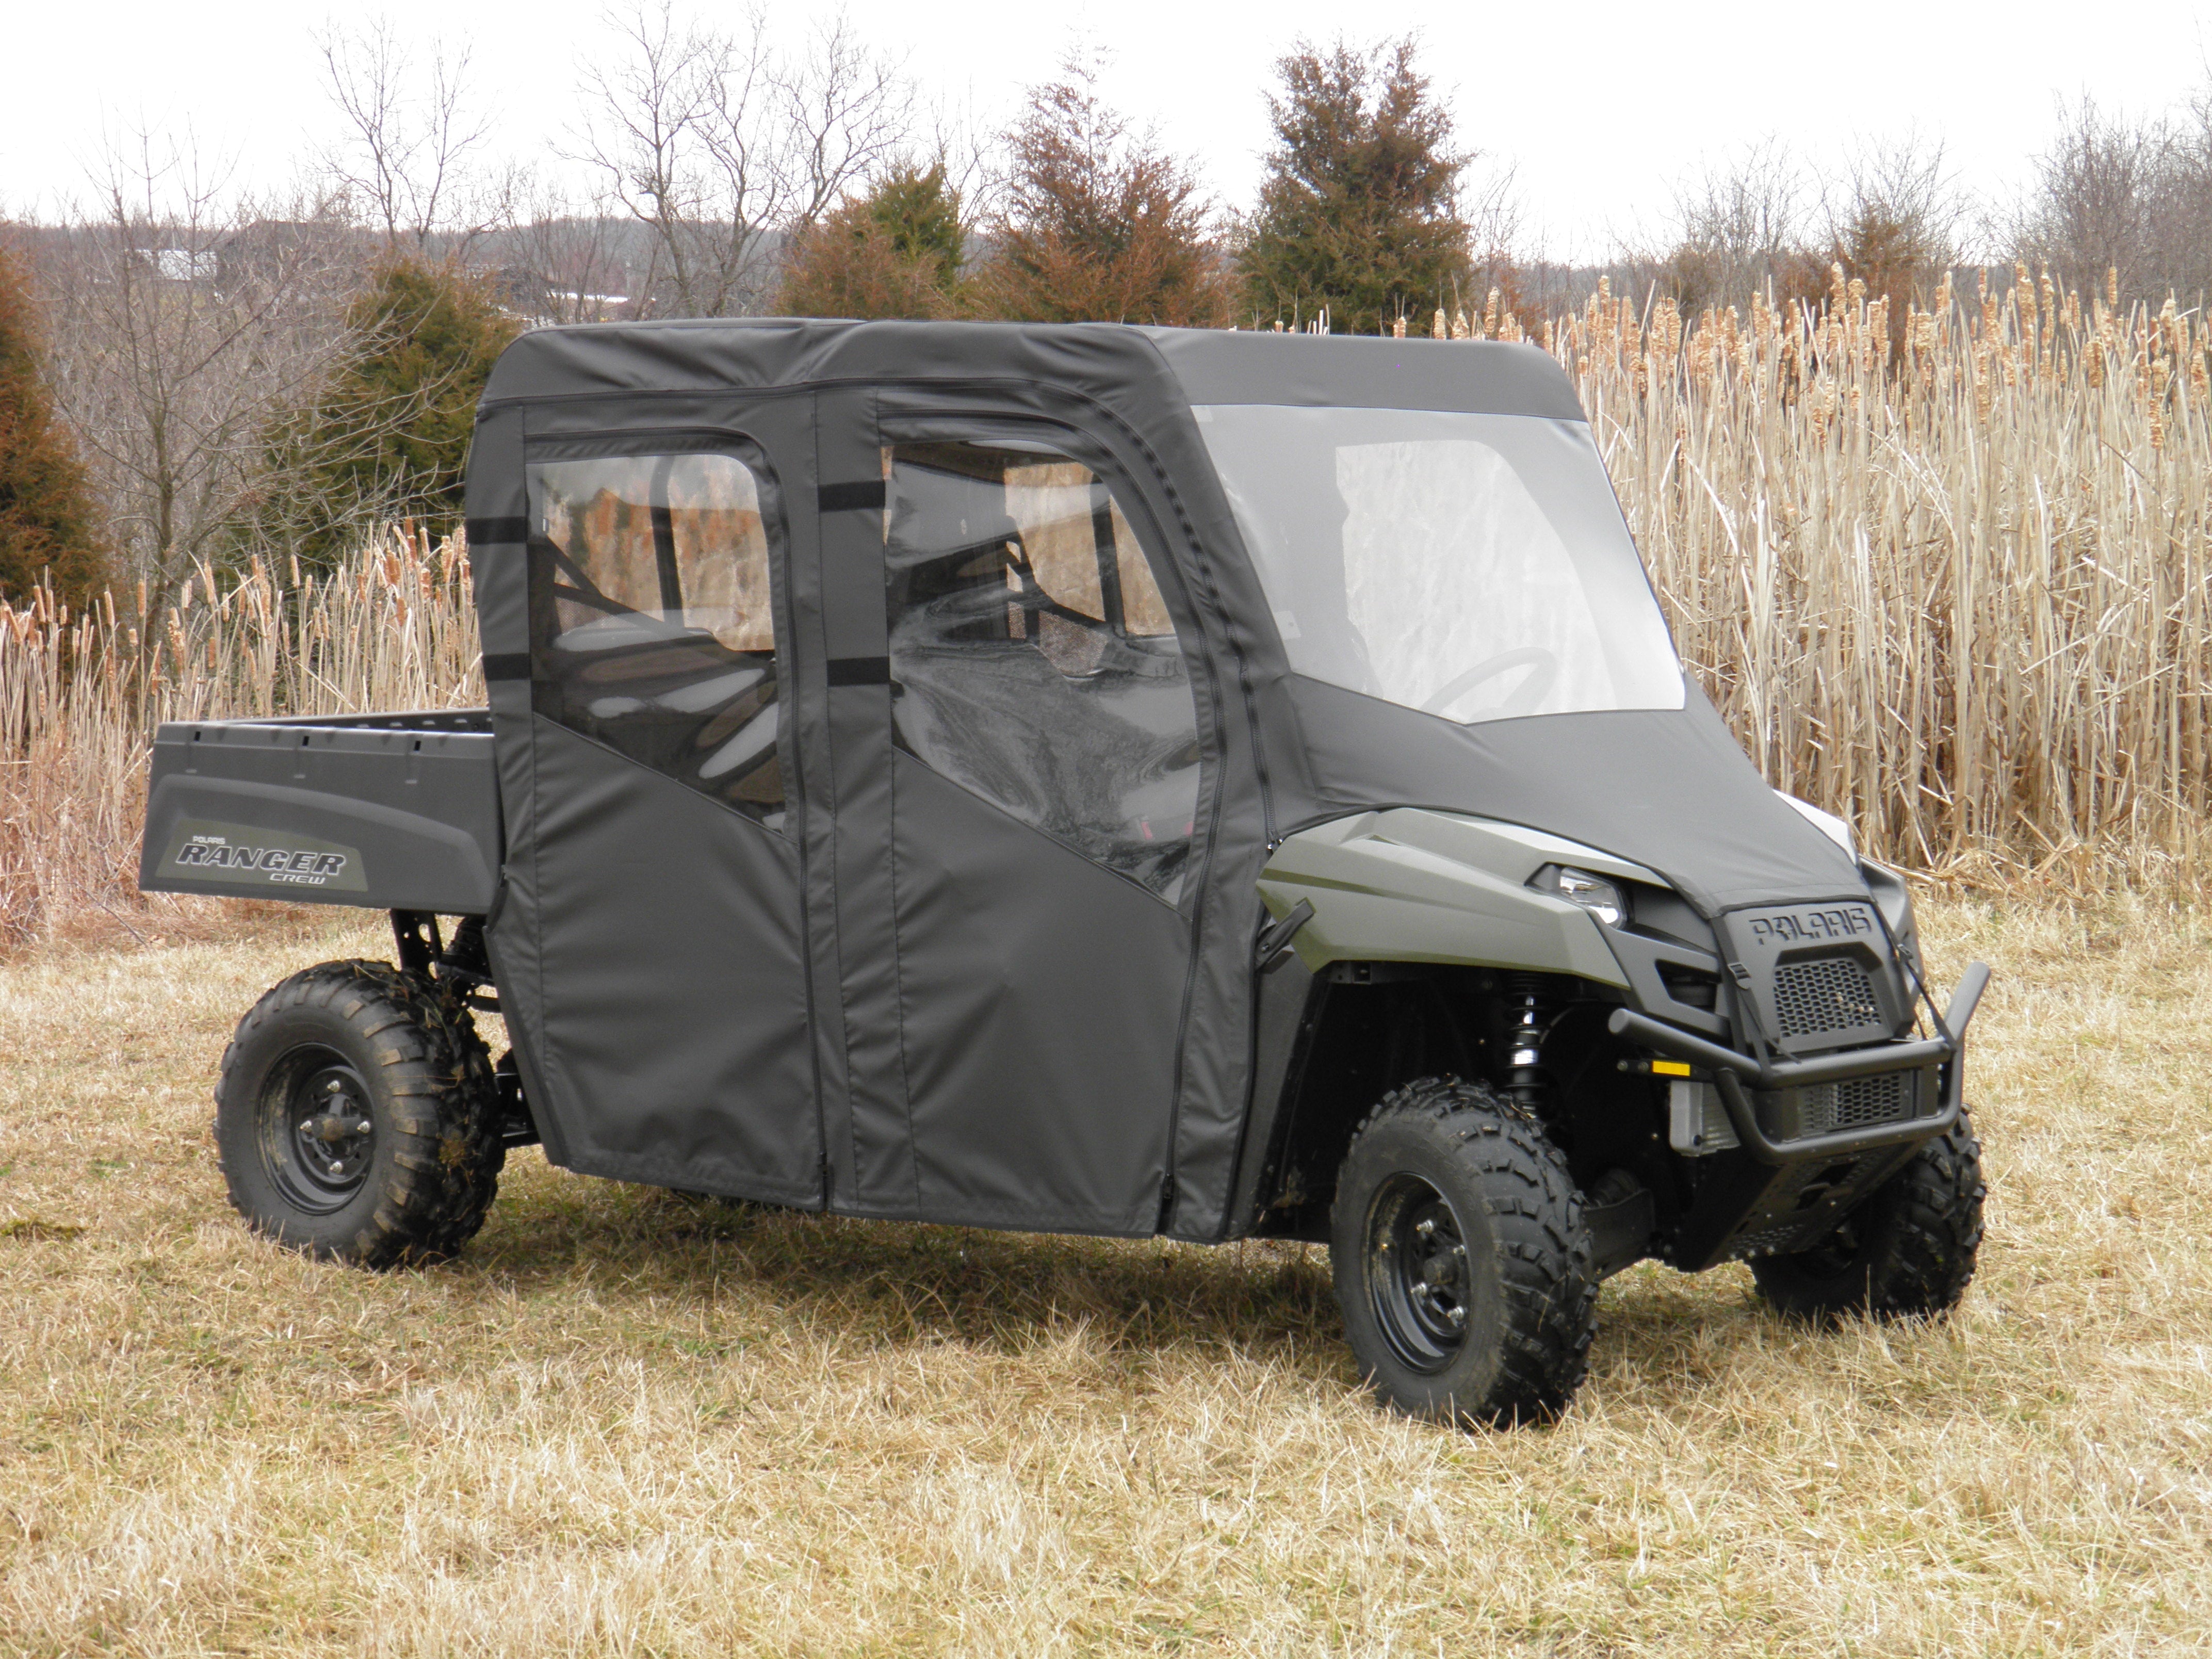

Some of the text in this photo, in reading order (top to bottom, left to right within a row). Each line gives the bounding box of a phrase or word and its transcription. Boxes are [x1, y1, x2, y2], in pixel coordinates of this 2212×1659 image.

[192, 836, 225, 844] POLARIS
[176, 843, 346, 875] RANGER
[270, 873, 326, 885] CREW
[1749, 908, 1872, 945] POLARIS
